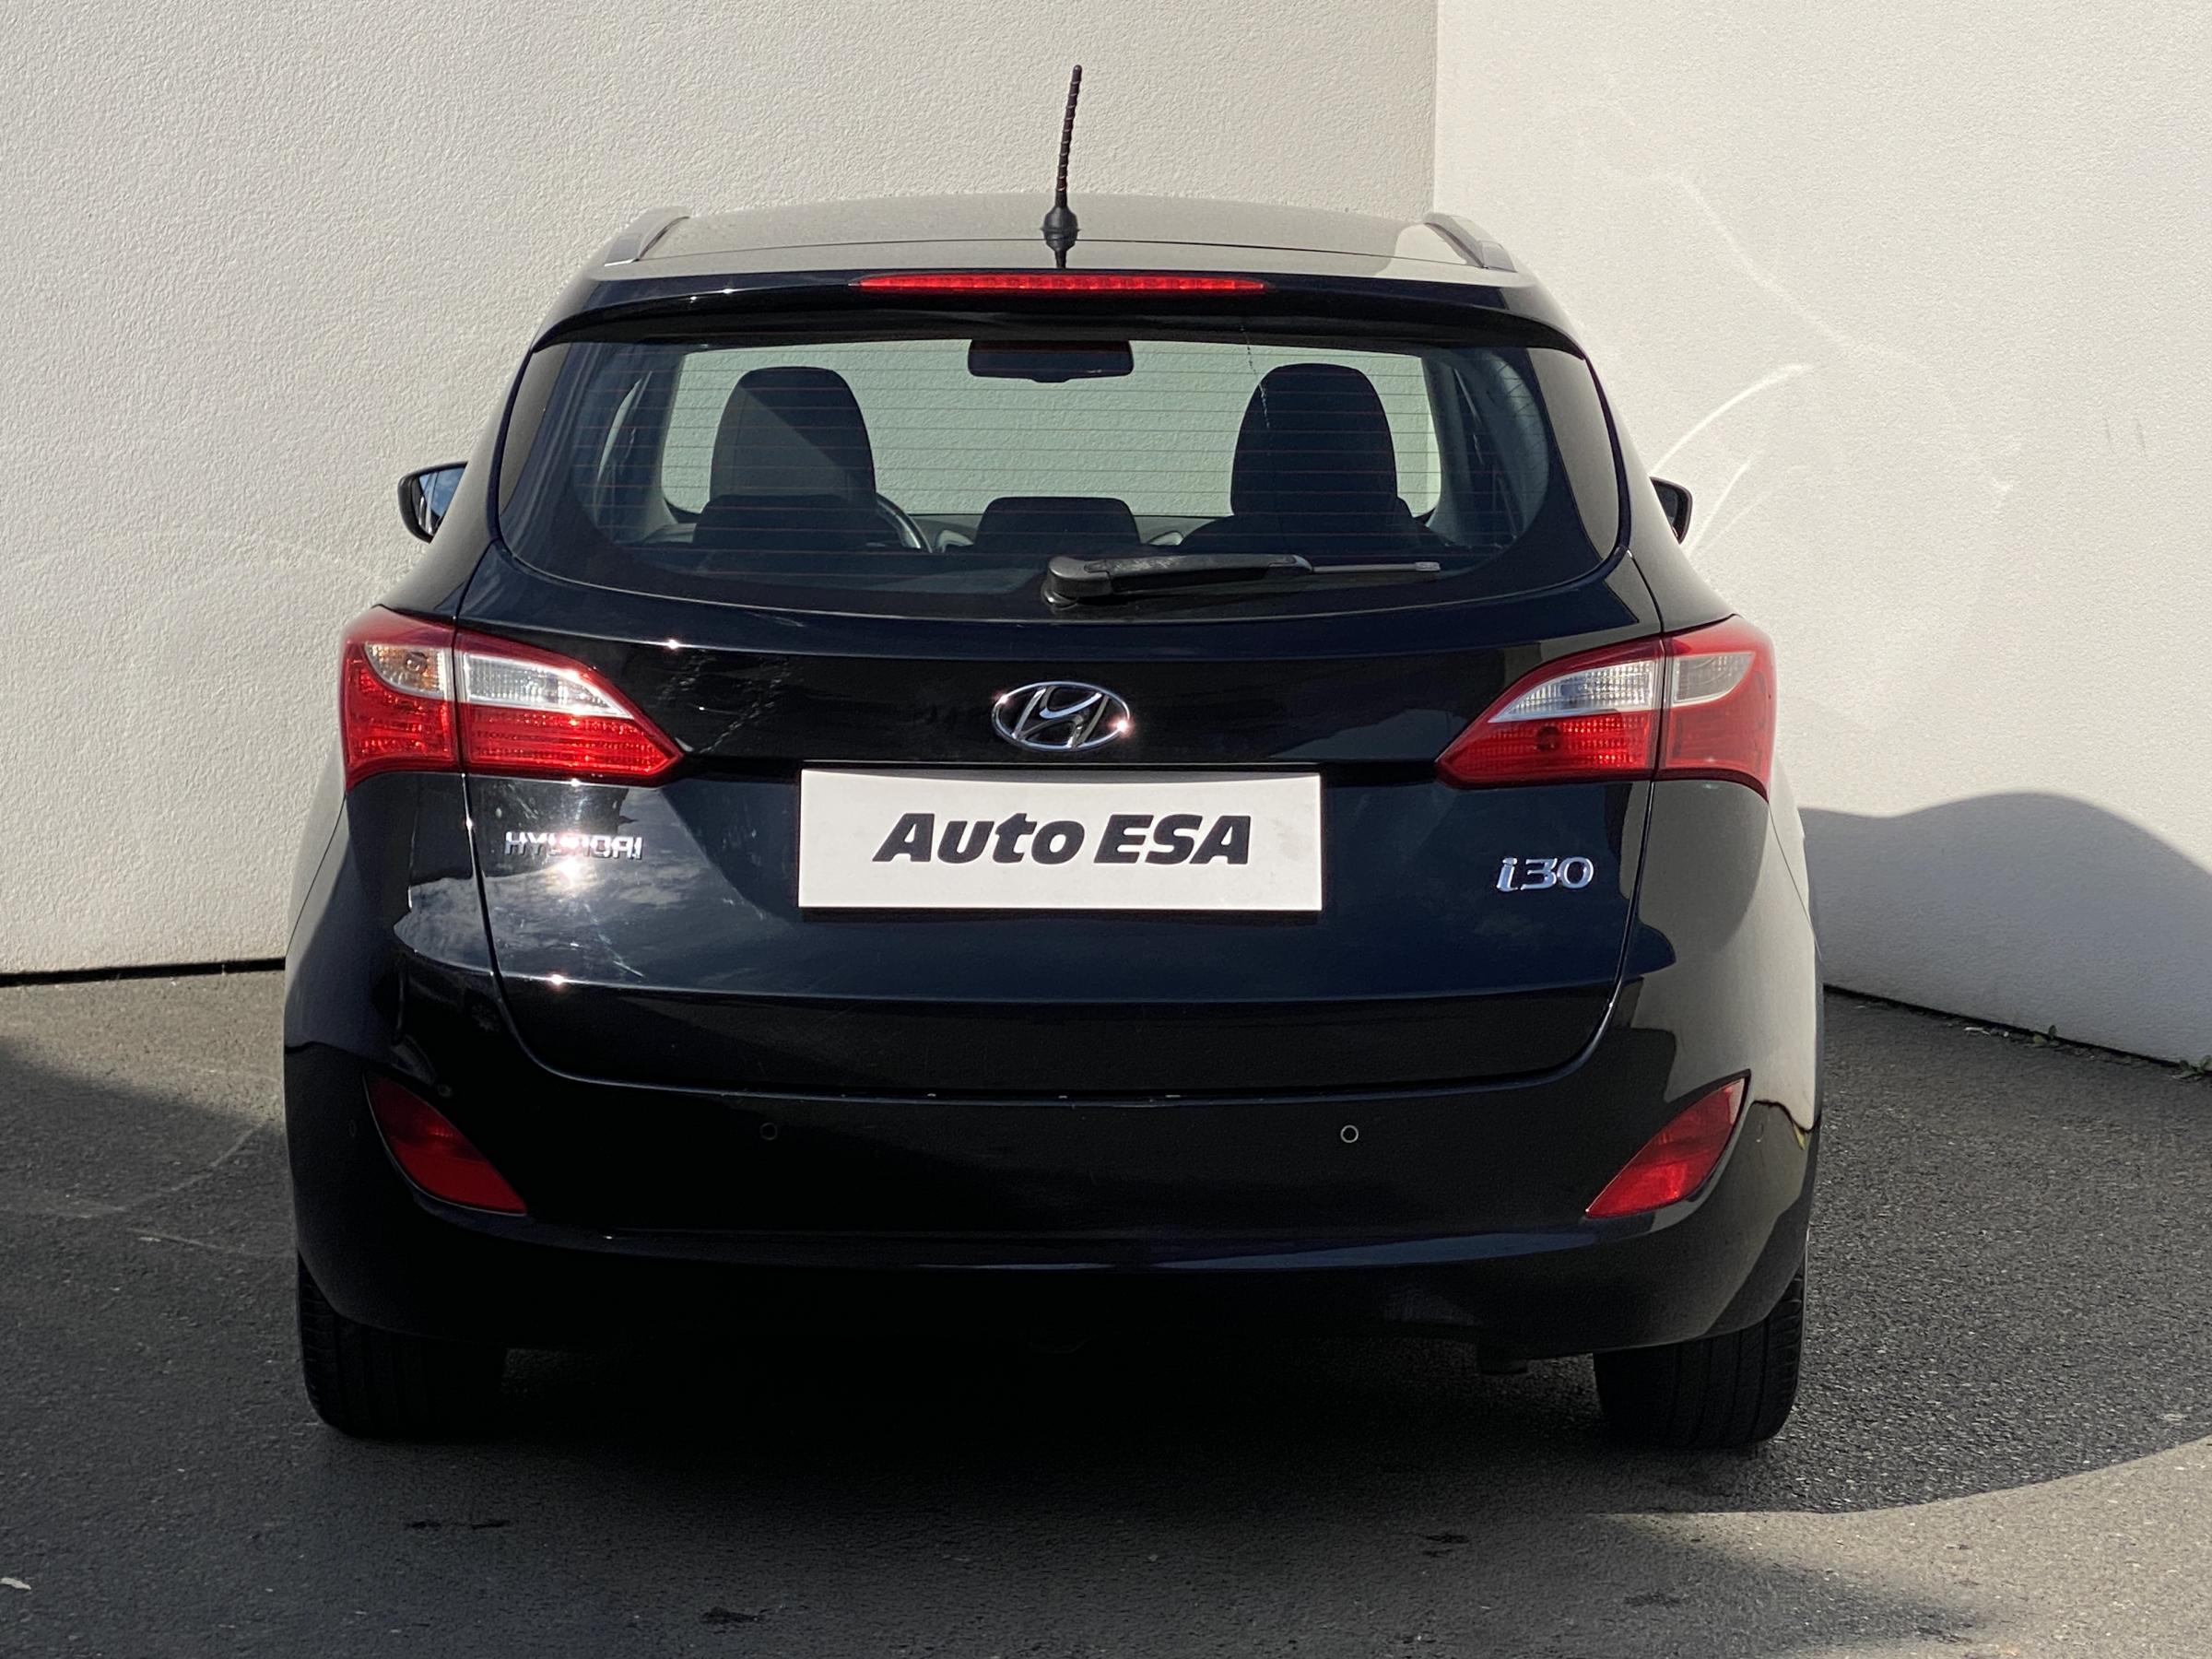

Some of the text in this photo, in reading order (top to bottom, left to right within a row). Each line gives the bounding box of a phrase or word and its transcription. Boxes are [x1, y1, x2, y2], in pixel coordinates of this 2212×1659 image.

[872, 813, 1252, 865] Auto ESA
[1496, 856, 1594, 892] i30
